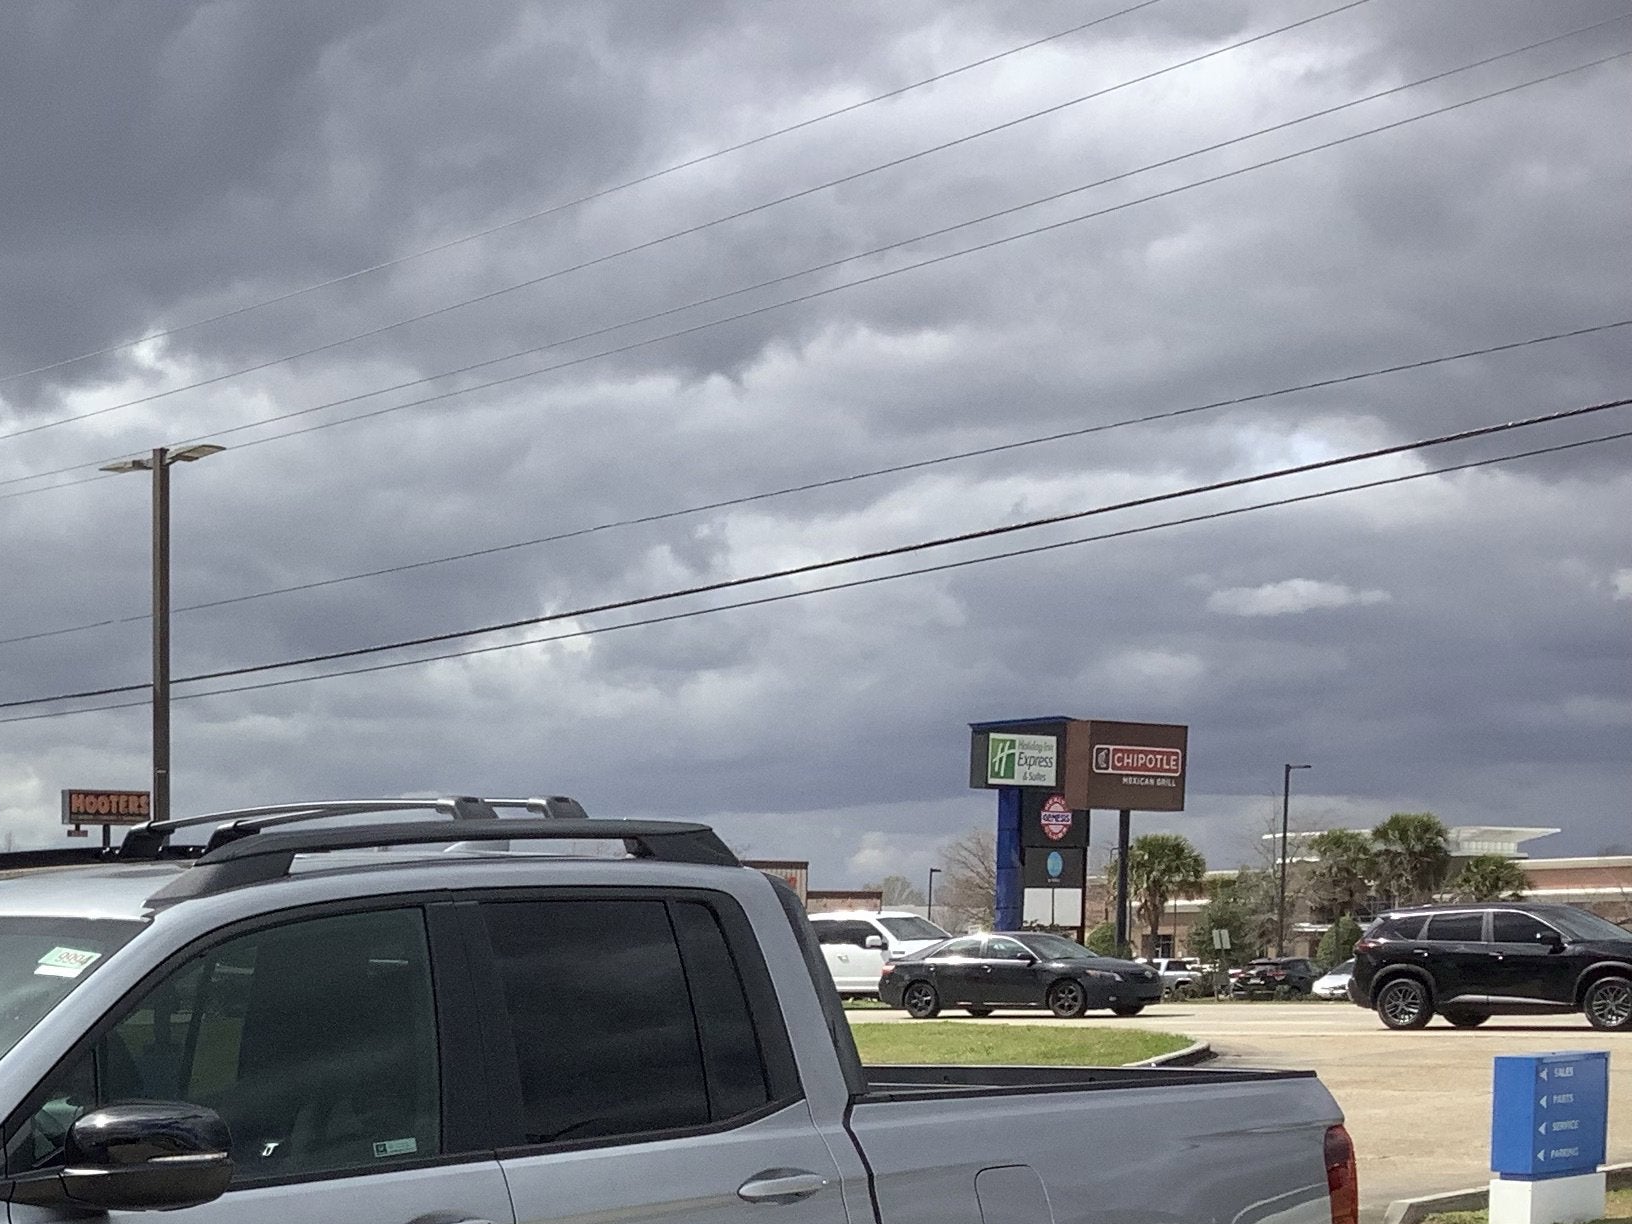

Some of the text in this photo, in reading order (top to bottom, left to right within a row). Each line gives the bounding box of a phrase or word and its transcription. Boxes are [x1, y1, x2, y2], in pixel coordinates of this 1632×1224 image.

[1017, 752, 1054, 770] Express
[1114, 753, 1178, 769] CHIPOTLE
[1122, 777, 1176, 787] MEXICAN GRILL
[71, 793, 149, 815] HOOTERS
